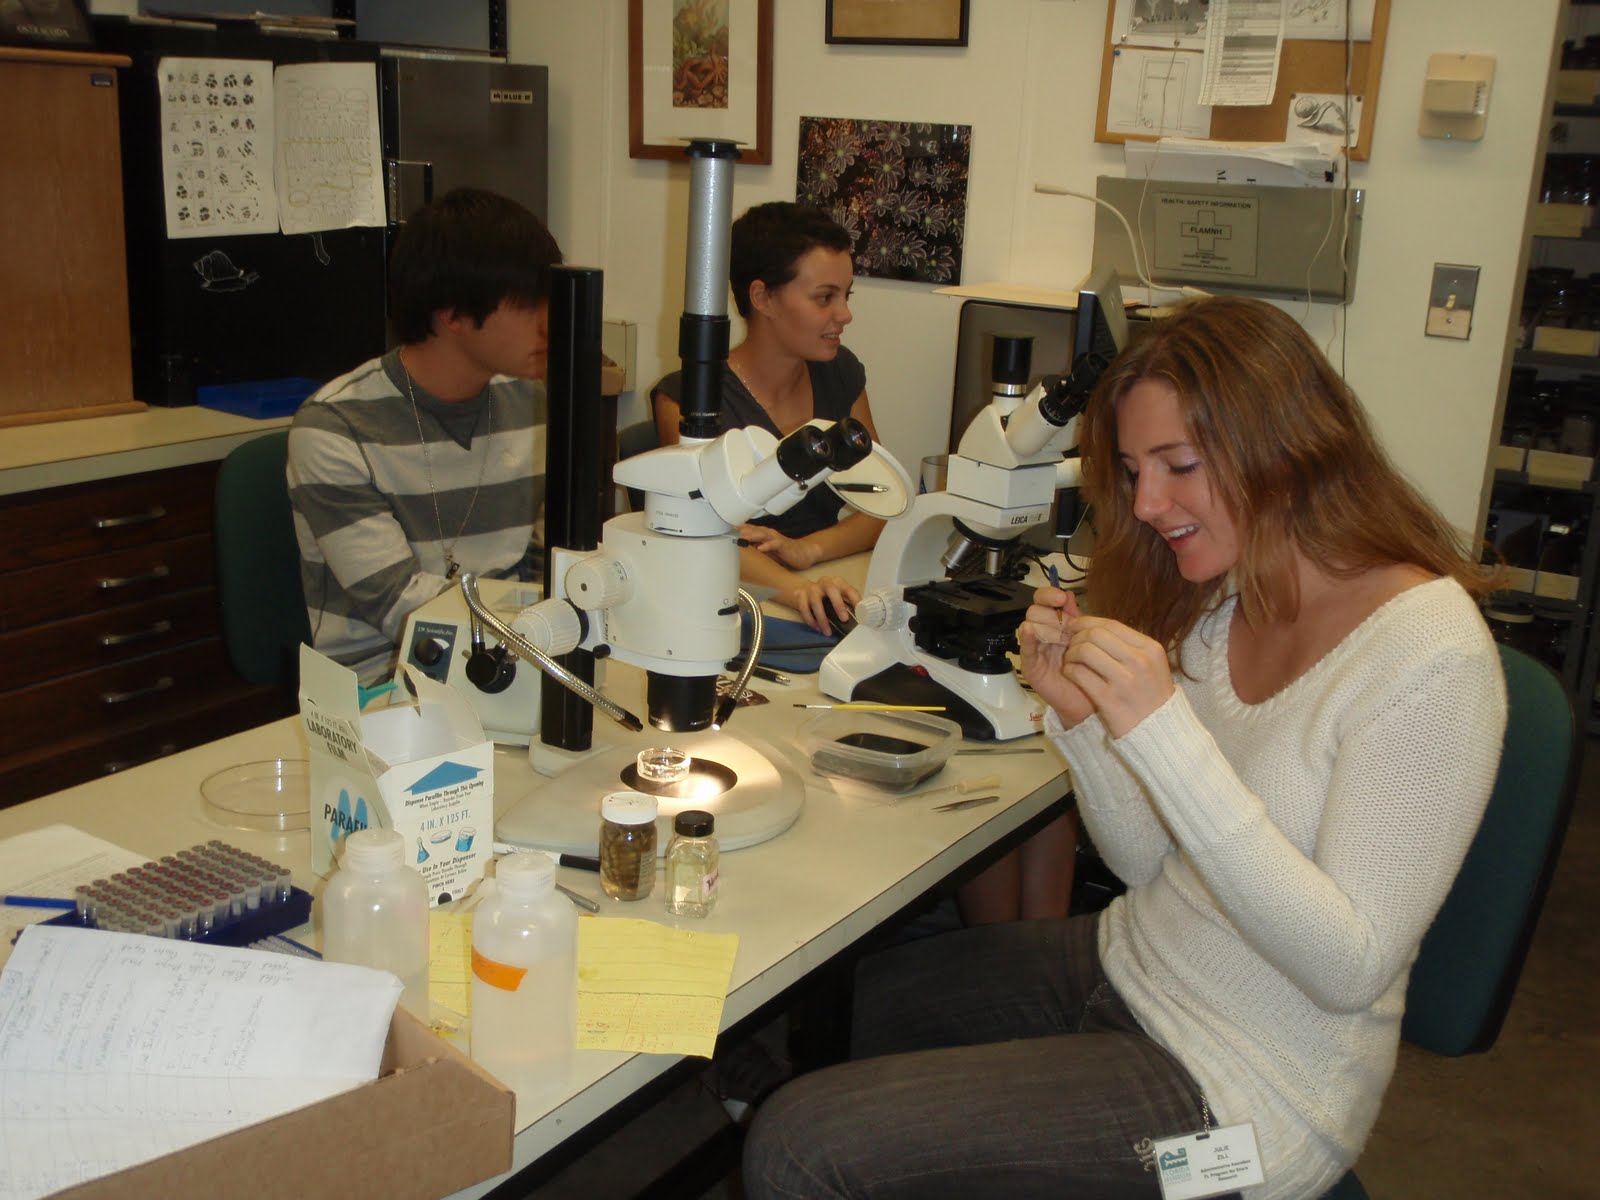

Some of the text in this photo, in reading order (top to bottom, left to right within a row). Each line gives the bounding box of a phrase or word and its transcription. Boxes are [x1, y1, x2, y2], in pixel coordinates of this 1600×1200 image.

[1187, 199, 1208, 207] SAFETY
[1210, 201, 1251, 209] INFORMATION
[1190, 226, 1223, 235] FLAMNH
[1010, 515, 1028, 525] LEICA
[306, 718, 358, 754] LABORATORY
[327, 742, 348, 761] FILM
[405, 796, 424, 807] Dispense
[443, 788, 460, 798] Through
[461, 784, 469, 792] This
[469, 780, 484, 790] Opening
[324, 803, 370, 833] PARAF
[420, 809, 471, 832] 4 IN. X 125 FT.
[422, 865, 432, 874] Use
[440, 859, 451, 868] Your
[452, 852, 477, 863] Dispenser
[1213, 1145, 1230, 1153] JULIE
